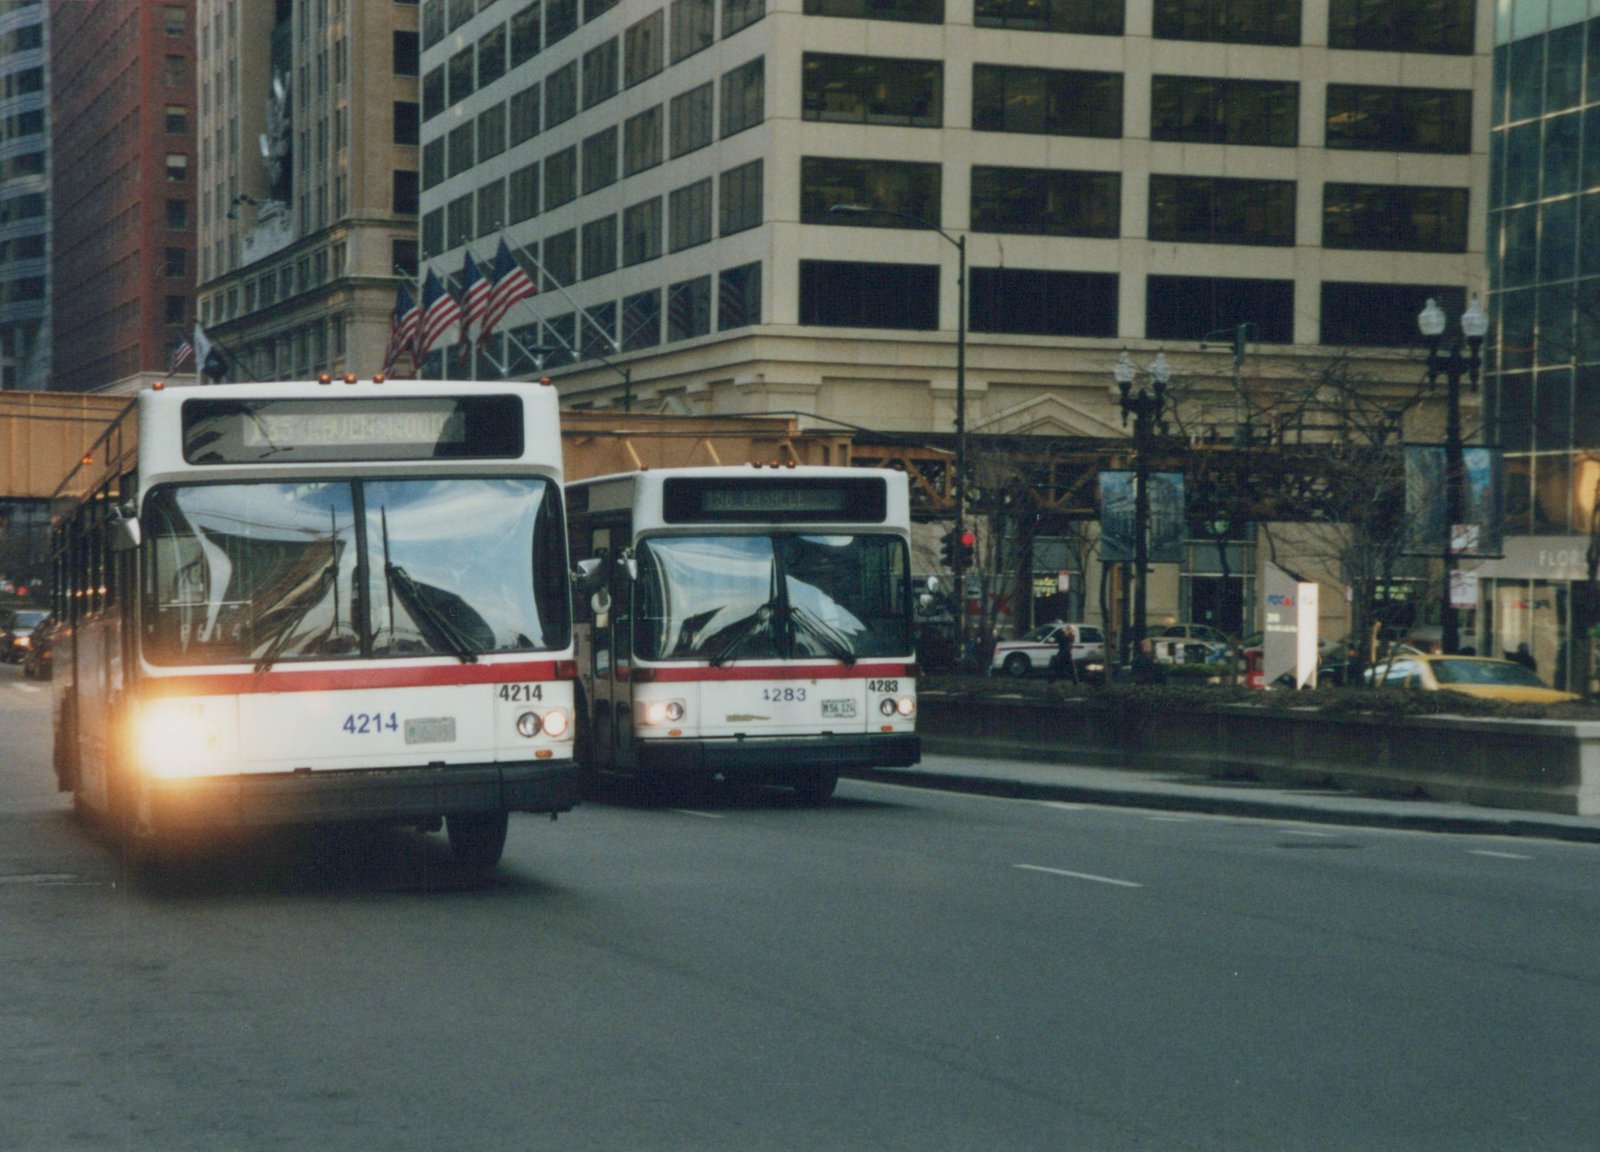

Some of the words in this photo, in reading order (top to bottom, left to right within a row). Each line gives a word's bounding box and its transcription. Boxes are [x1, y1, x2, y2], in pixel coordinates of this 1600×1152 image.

[499, 683, 543, 702] 4214
[868, 679, 898, 693] 4283
[342, 712, 399, 735] 4214
